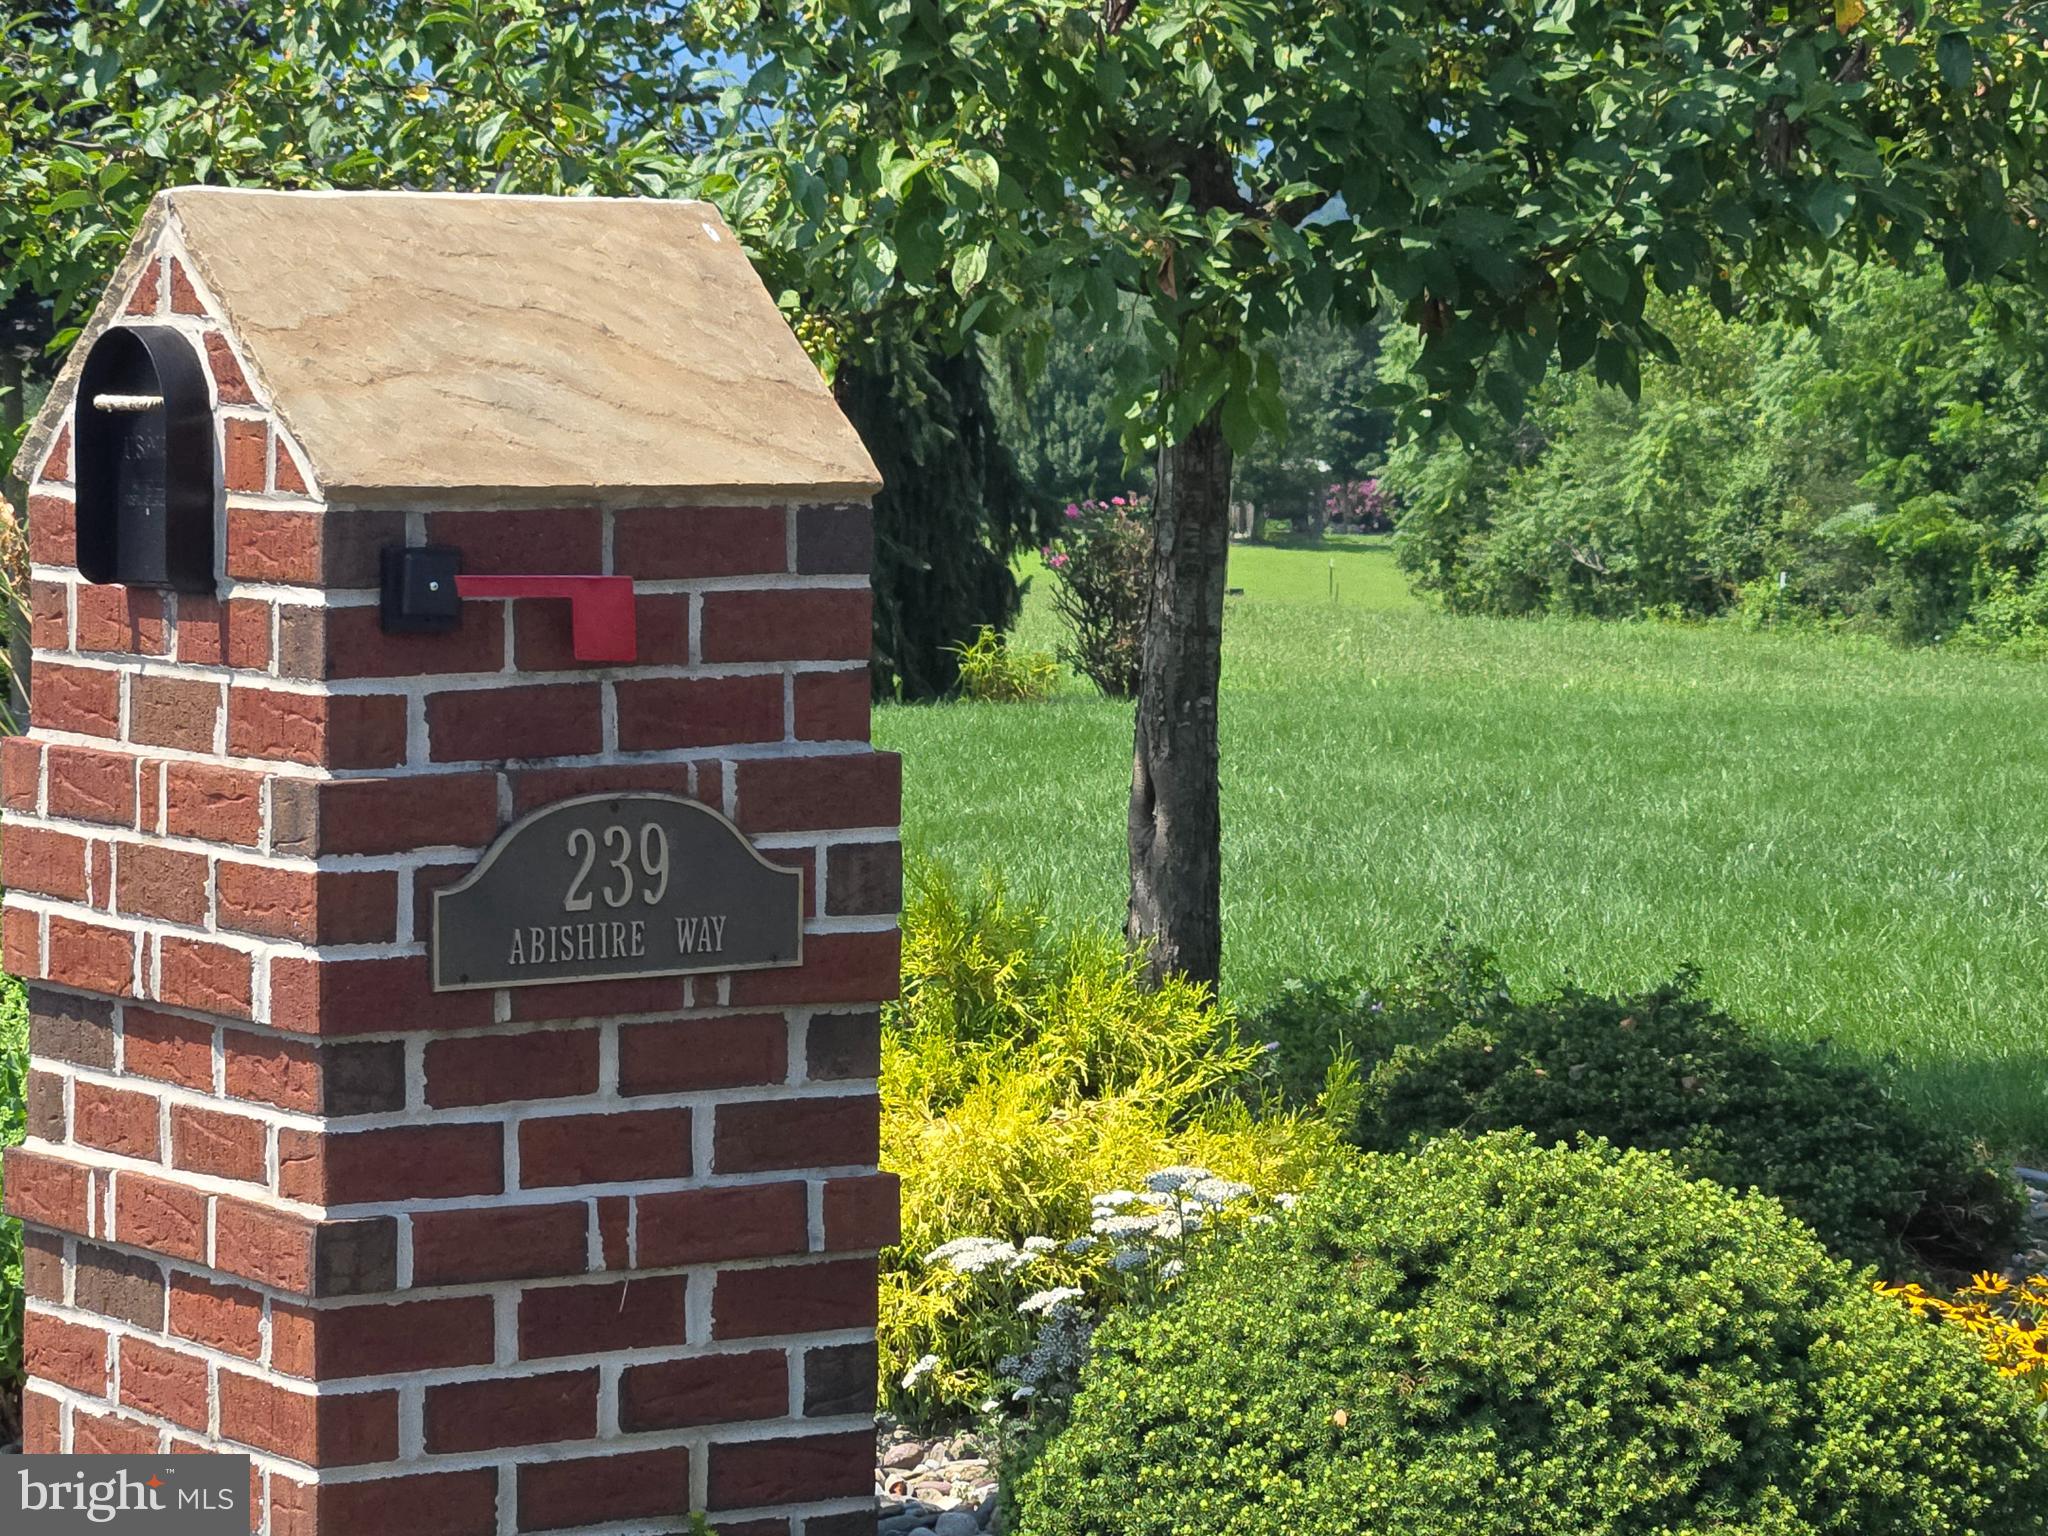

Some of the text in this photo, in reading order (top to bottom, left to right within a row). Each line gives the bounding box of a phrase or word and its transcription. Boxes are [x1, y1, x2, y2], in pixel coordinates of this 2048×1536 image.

[564, 823, 670, 911] 239
[509, 915, 727, 964] ABISHIRE WAY
